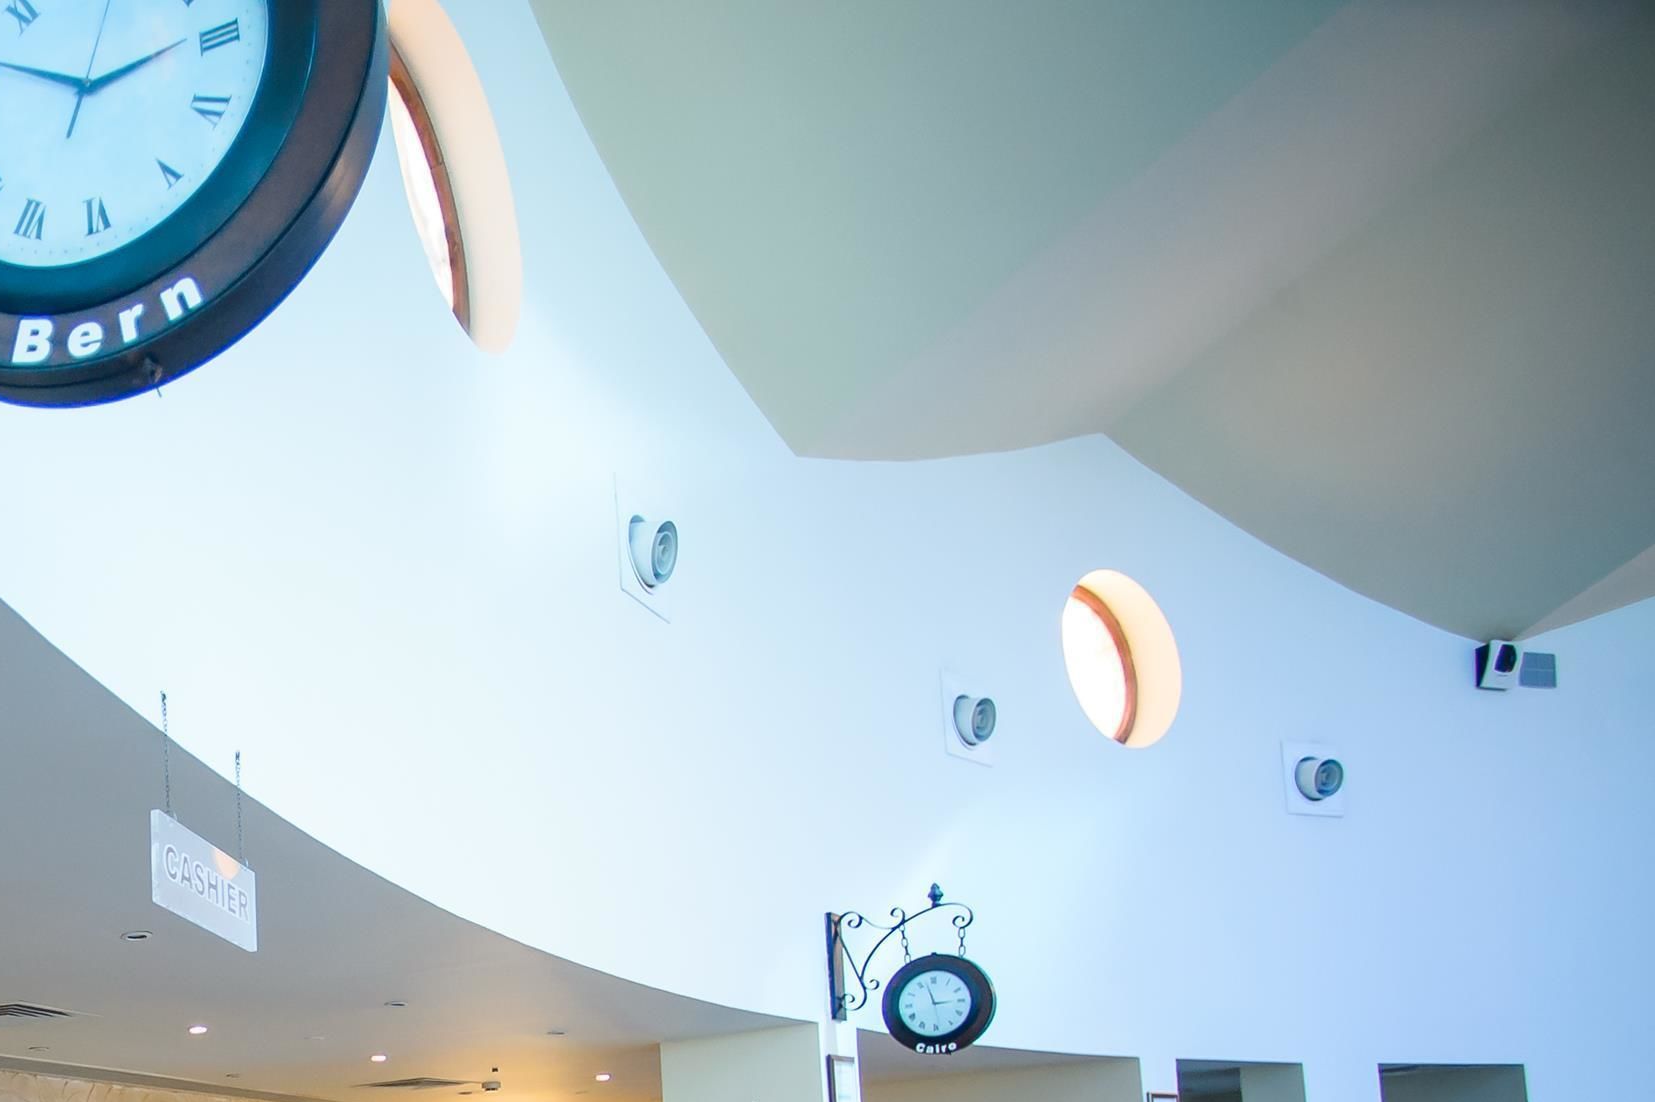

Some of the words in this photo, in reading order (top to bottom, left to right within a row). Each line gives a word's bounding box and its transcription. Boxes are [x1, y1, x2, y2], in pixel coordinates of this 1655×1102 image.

[199, 17, 240, 56] III
[191, 94, 232, 130] IV
[156, 158, 185, 190] V
[13, 198, 47, 240] VII
[83, 196, 111, 237] VI
[11, 275, 203, 364] Bern
[164, 845, 249, 922] CASHIER
[916, 1042, 957, 1054] Cairo
